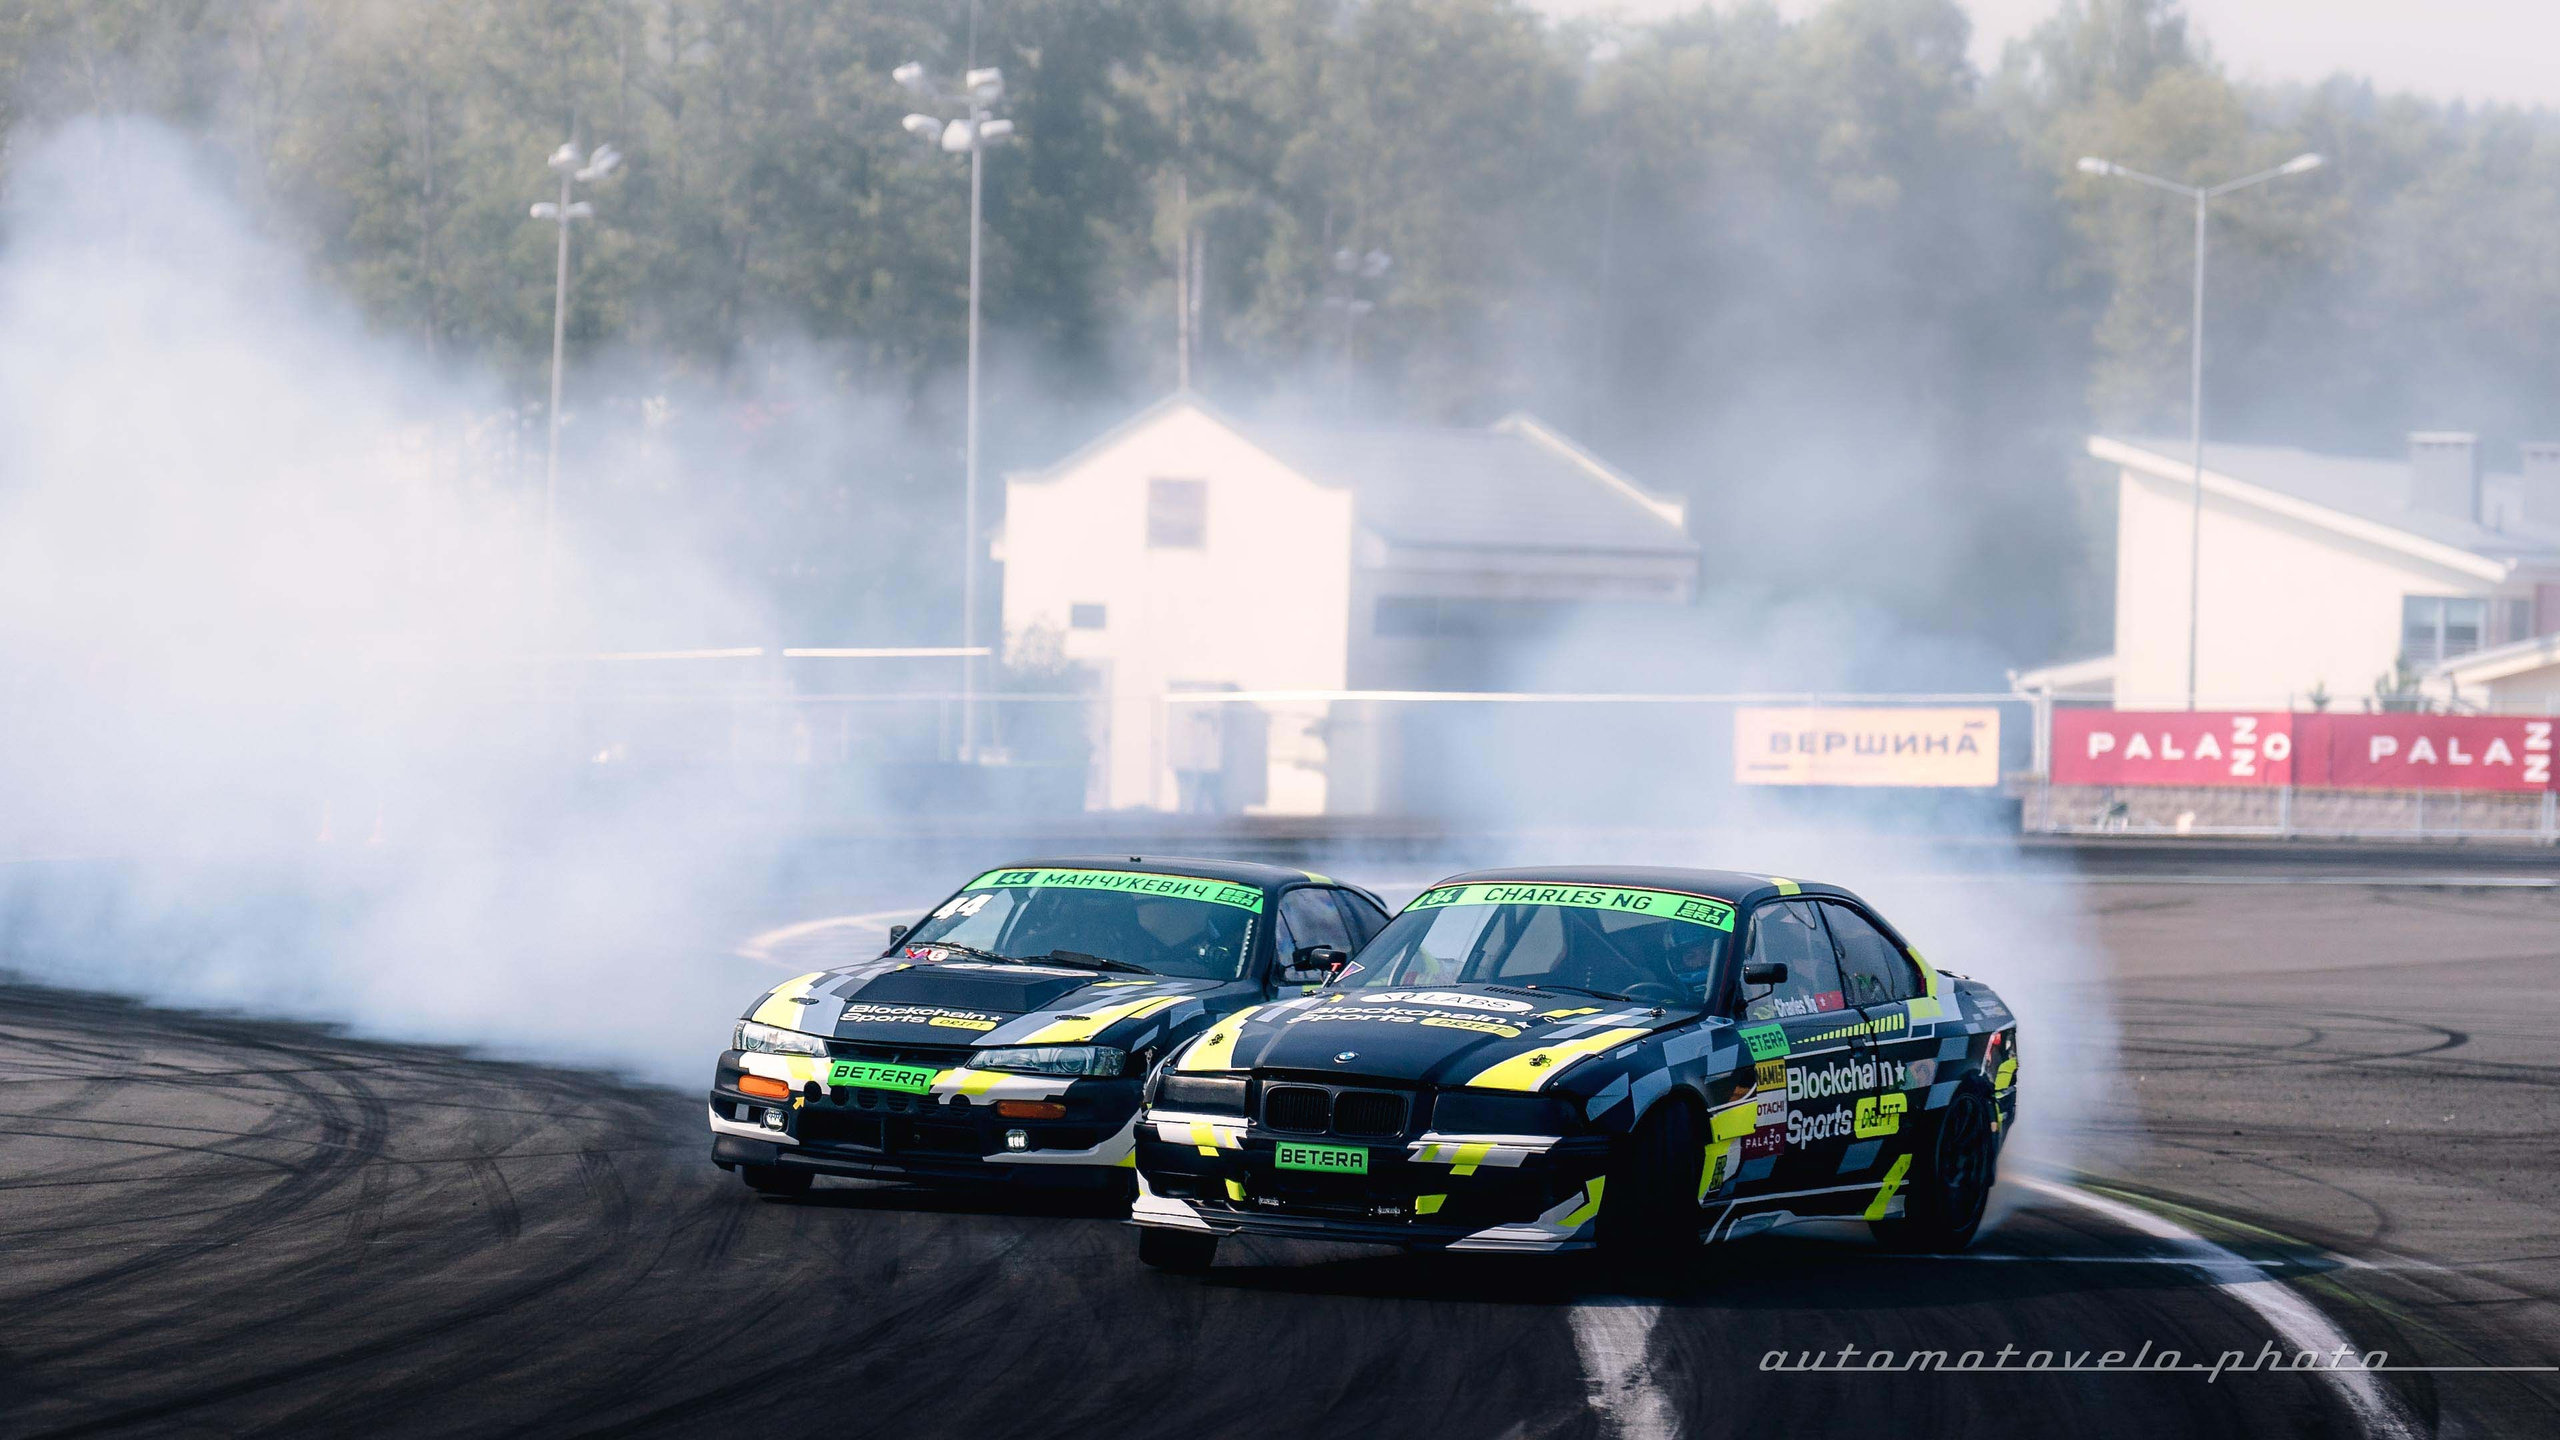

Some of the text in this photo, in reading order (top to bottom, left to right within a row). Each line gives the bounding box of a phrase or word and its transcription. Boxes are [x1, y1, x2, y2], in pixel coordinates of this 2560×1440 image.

[1770, 731, 1979, 755] ВЕРШИНА
[1042, 874, 1209, 897] МАНЧУКЕВИЧ
[932, 894, 994, 920] 44
[1484, 887, 1607, 906] CHARLES
[1610, 893, 1651, 911] NG
[840, 1012, 988, 1028] Sports DRIFT
[848, 1004, 987, 1021] Blockchain
[1435, 1019, 1510, 1032] DRIFT
[1743, 1030, 1787, 1053] ET.ERA
[834, 1065, 928, 1087] BET.ERA
[1787, 1055, 1894, 1102] Blockchain
[1786, 1104, 1853, 1150] Sports
[1281, 1148, 1363, 1168] BET.ERA
